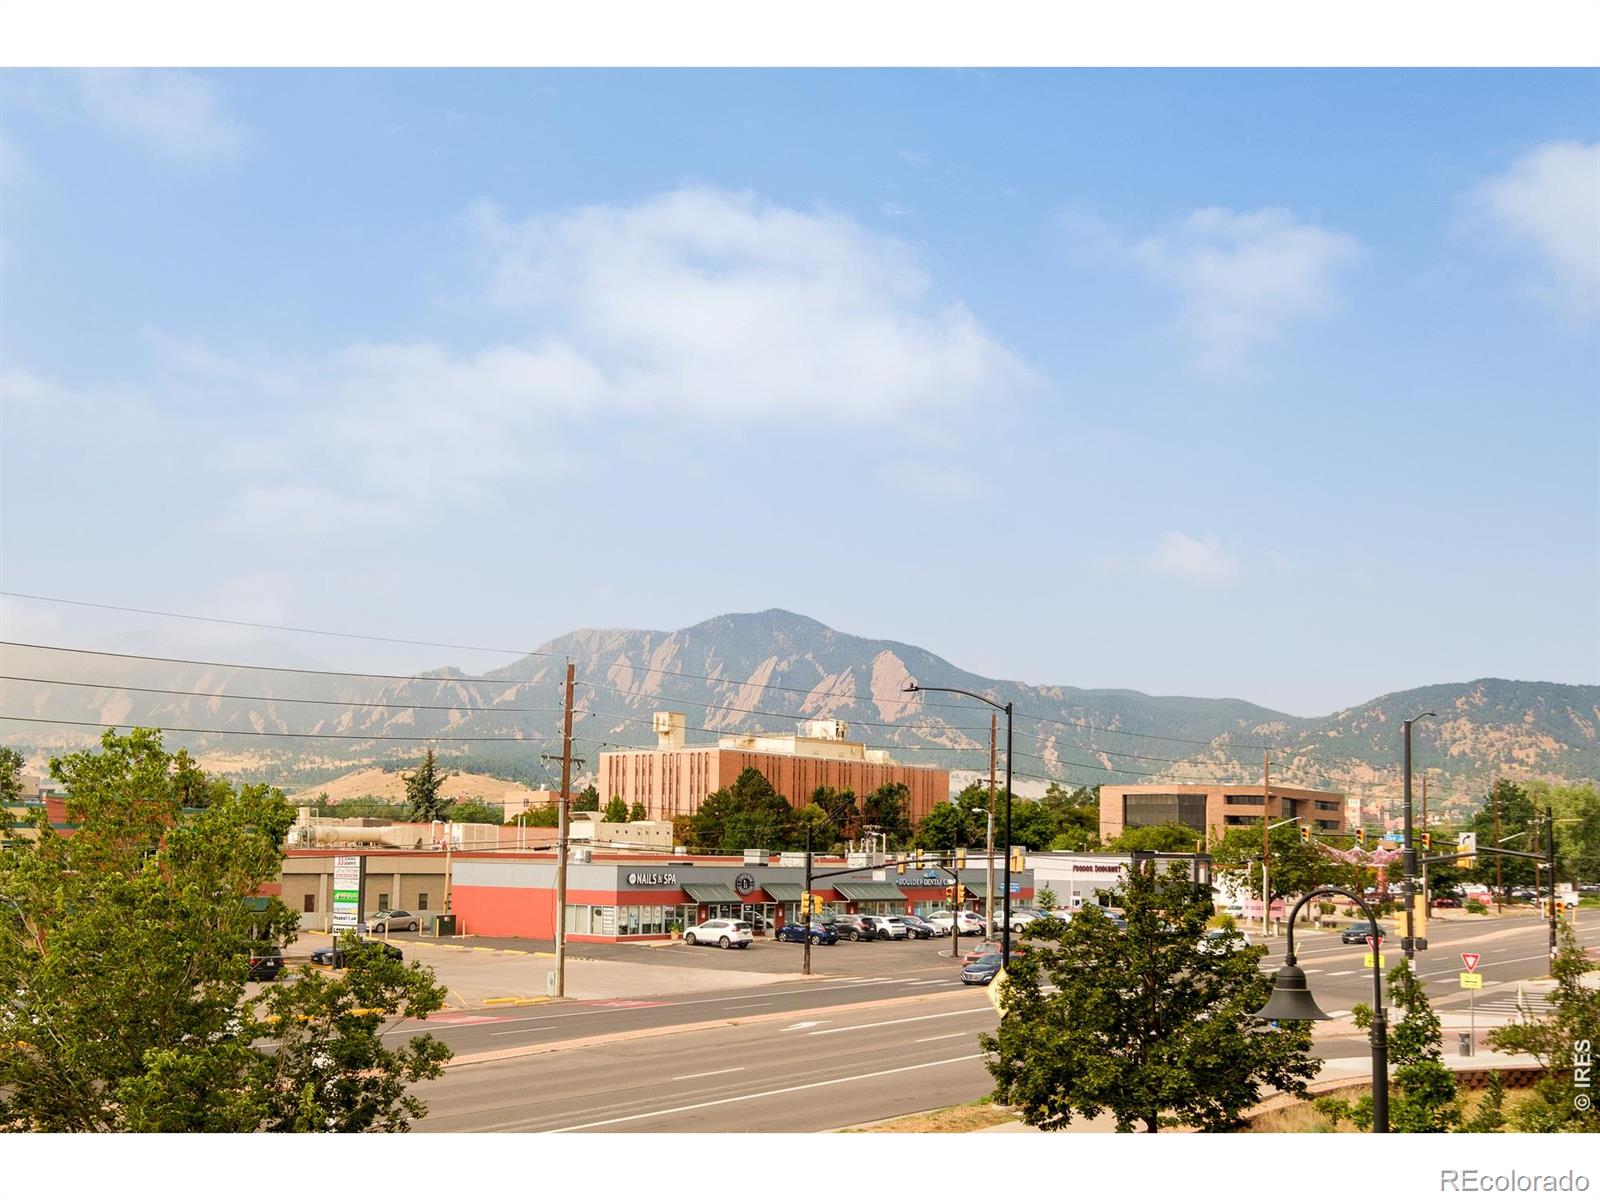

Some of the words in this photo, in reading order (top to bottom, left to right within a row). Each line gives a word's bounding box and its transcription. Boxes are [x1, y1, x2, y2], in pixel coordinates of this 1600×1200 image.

[636, 873, 657, 885] NAILS
[657, 875, 663, 884] &
[663, 873, 677, 885] SPA
